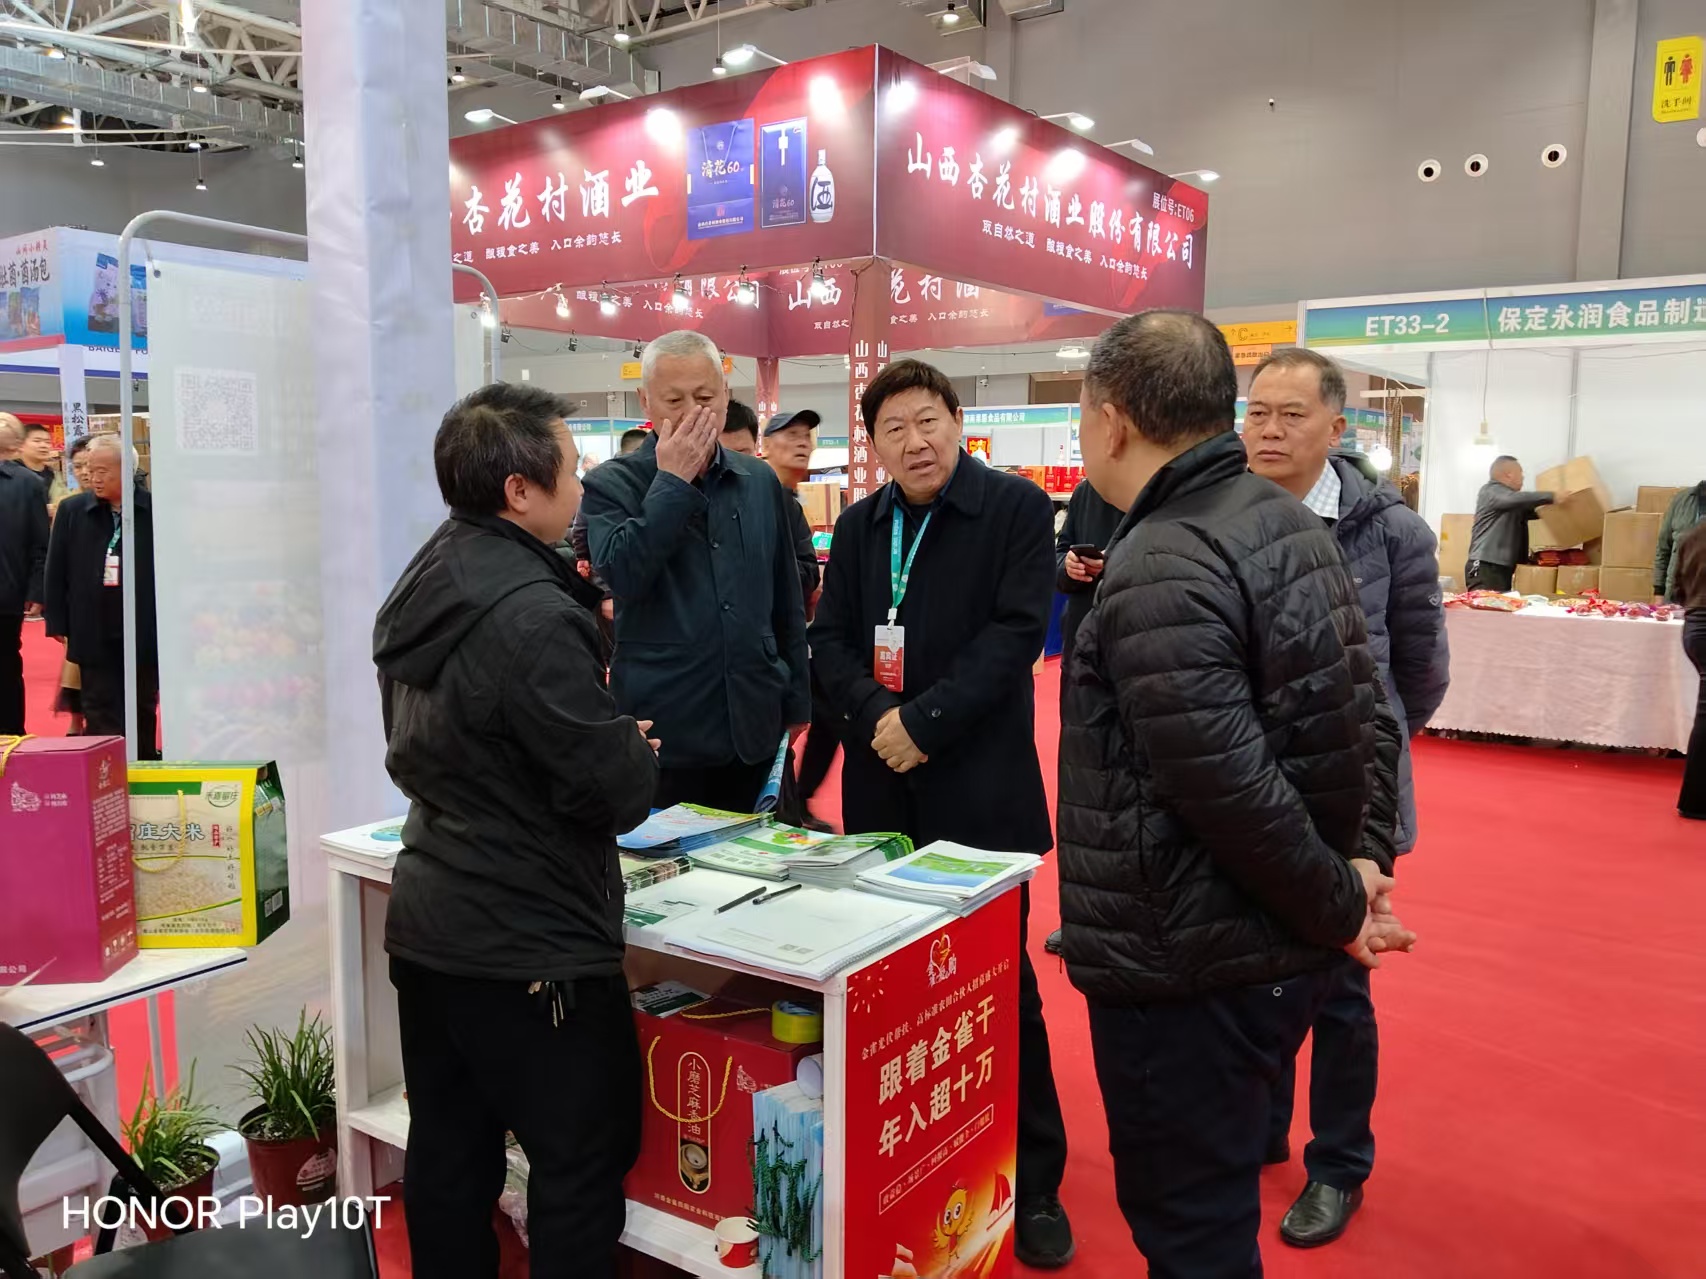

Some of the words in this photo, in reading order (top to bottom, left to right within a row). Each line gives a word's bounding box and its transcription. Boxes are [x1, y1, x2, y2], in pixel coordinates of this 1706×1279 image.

[463, 159, 659, 235] 杏花村酒业
[907, 132, 1194, 269] 山西杏花村酒业股份有限公司
[982, 219, 1036, 248] 取自然之道
[550, 230, 622, 251] 入口余韵悠长
[1365, 312, 1450, 338] ET33-2
[878, 994, 996, 1105] 跟着金雀干
[878, 1045, 996, 1158] 年入超十万
